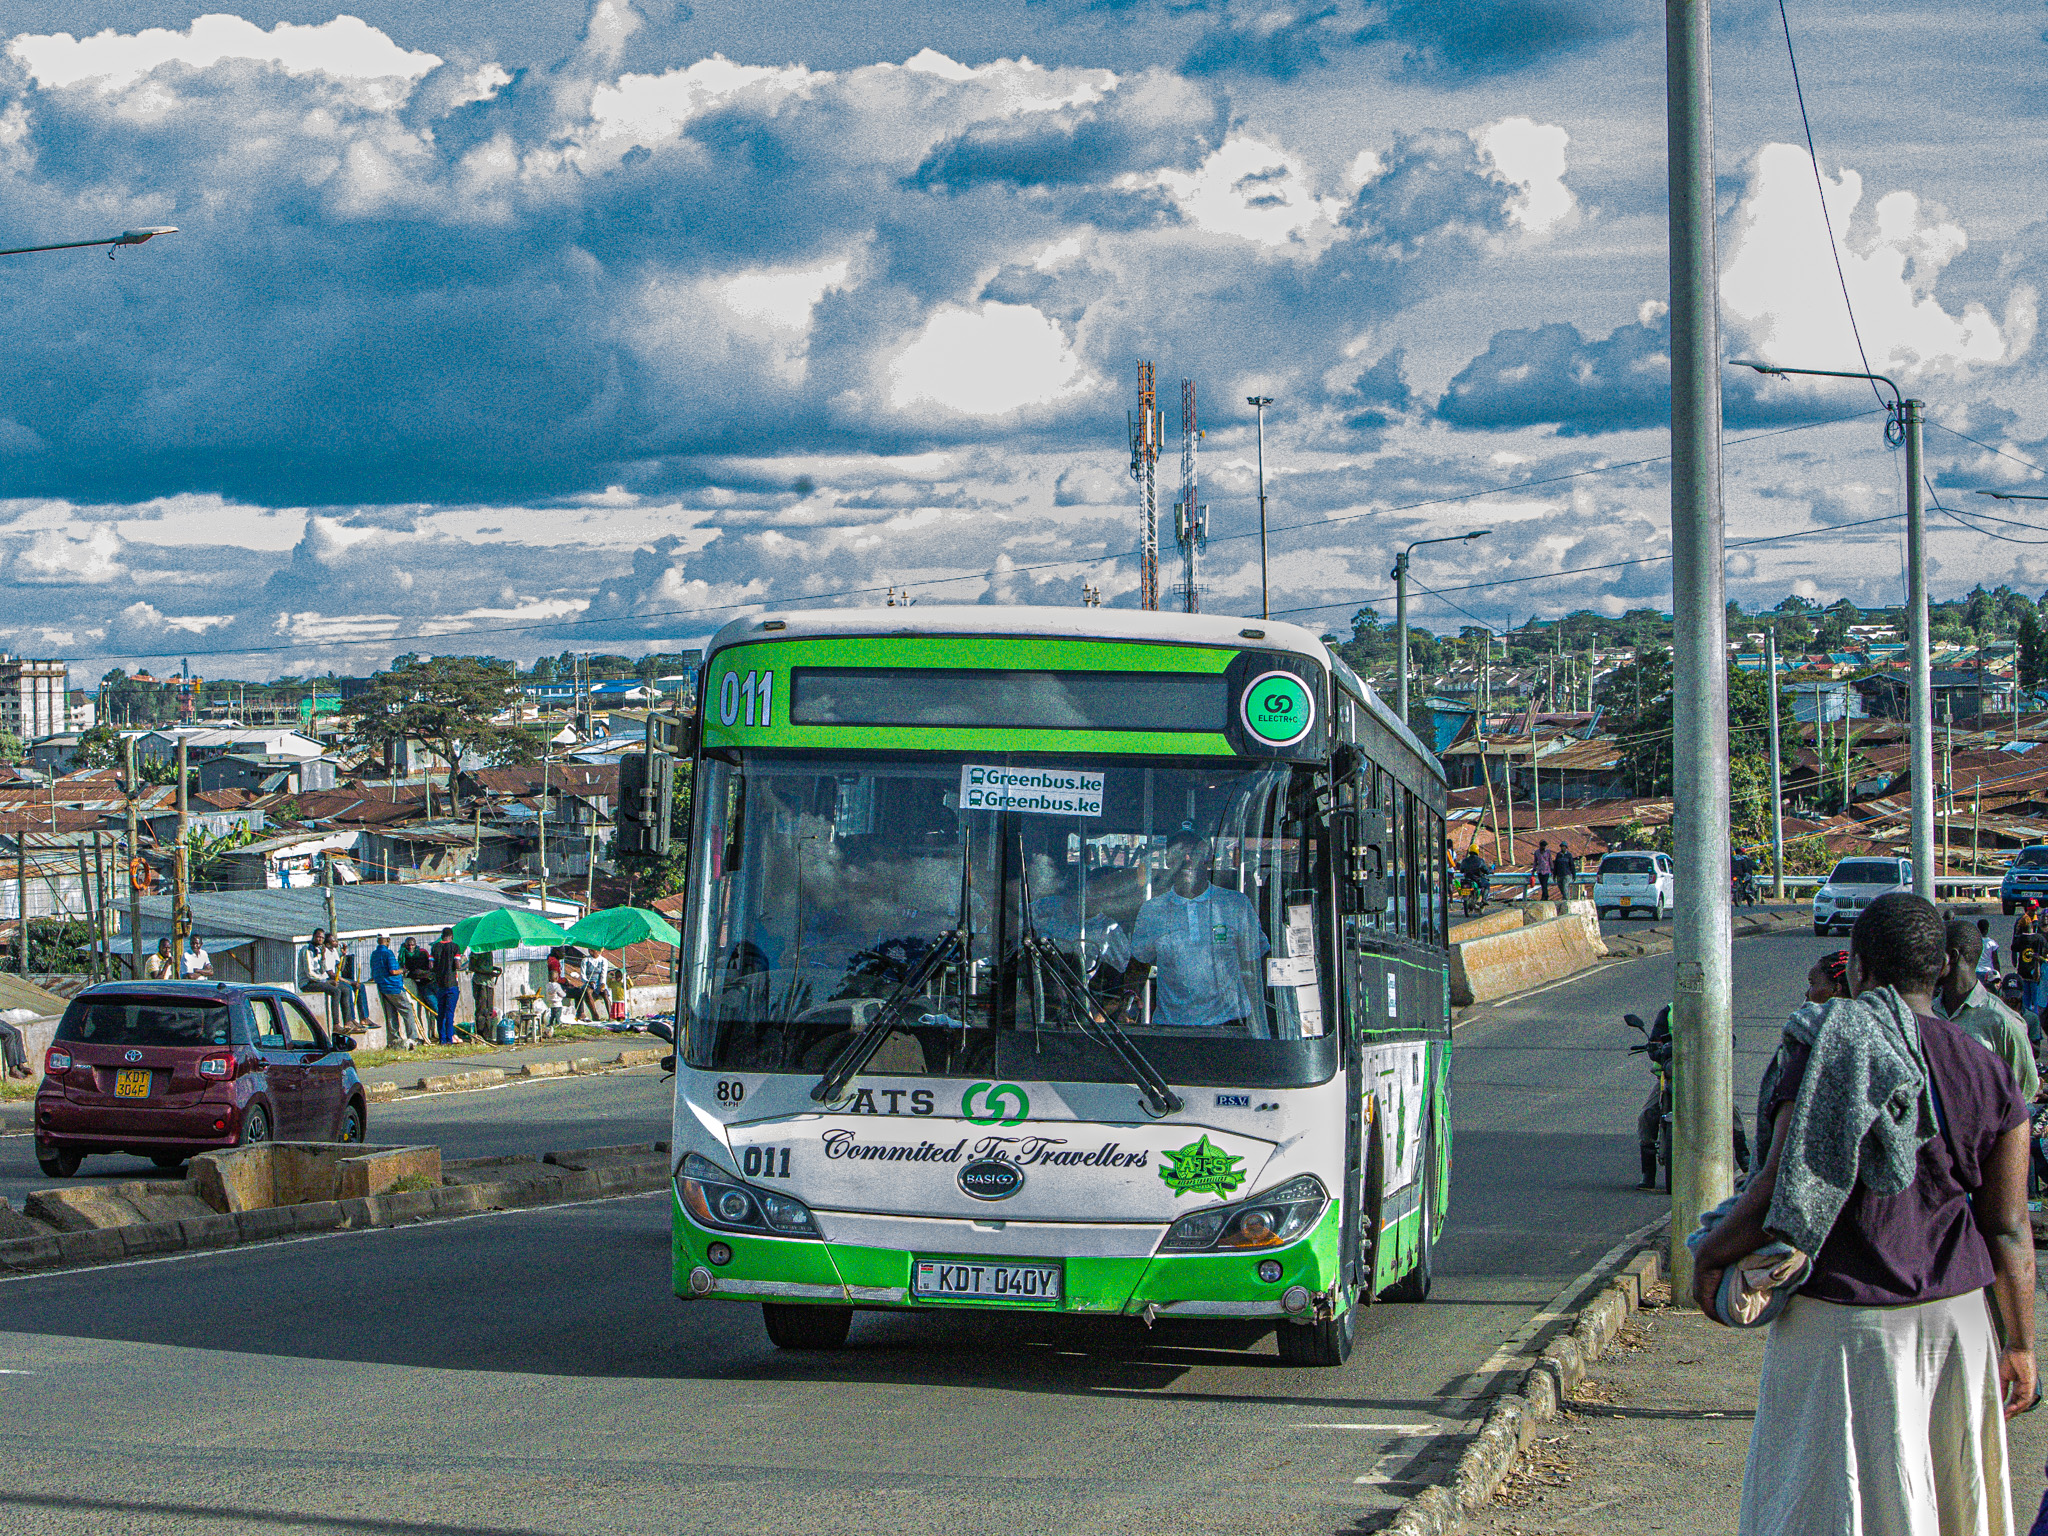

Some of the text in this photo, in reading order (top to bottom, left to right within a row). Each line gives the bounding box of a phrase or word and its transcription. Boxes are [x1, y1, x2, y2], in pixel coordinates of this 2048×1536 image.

[720, 670, 774, 727] 011
[986, 769, 1102, 791] Greenbus.ke
[984, 791, 1100, 813] Greenbus.ke
[125, 1071, 146, 1083] KDT
[117, 1084, 145, 1096] 304F
[717, 1081, 744, 1101] 80
[850, 1088, 934, 1115] ATS
[821, 1128, 968, 1163] Commited
[967, 1136, 1021, 1162] To
[1014, 1136, 1149, 1168] Travellers
[743, 1146, 791, 1178] 011
[1179, 1156, 1227, 1174] ATS
[939, 1265, 1053, 1295] KDT 040Y
